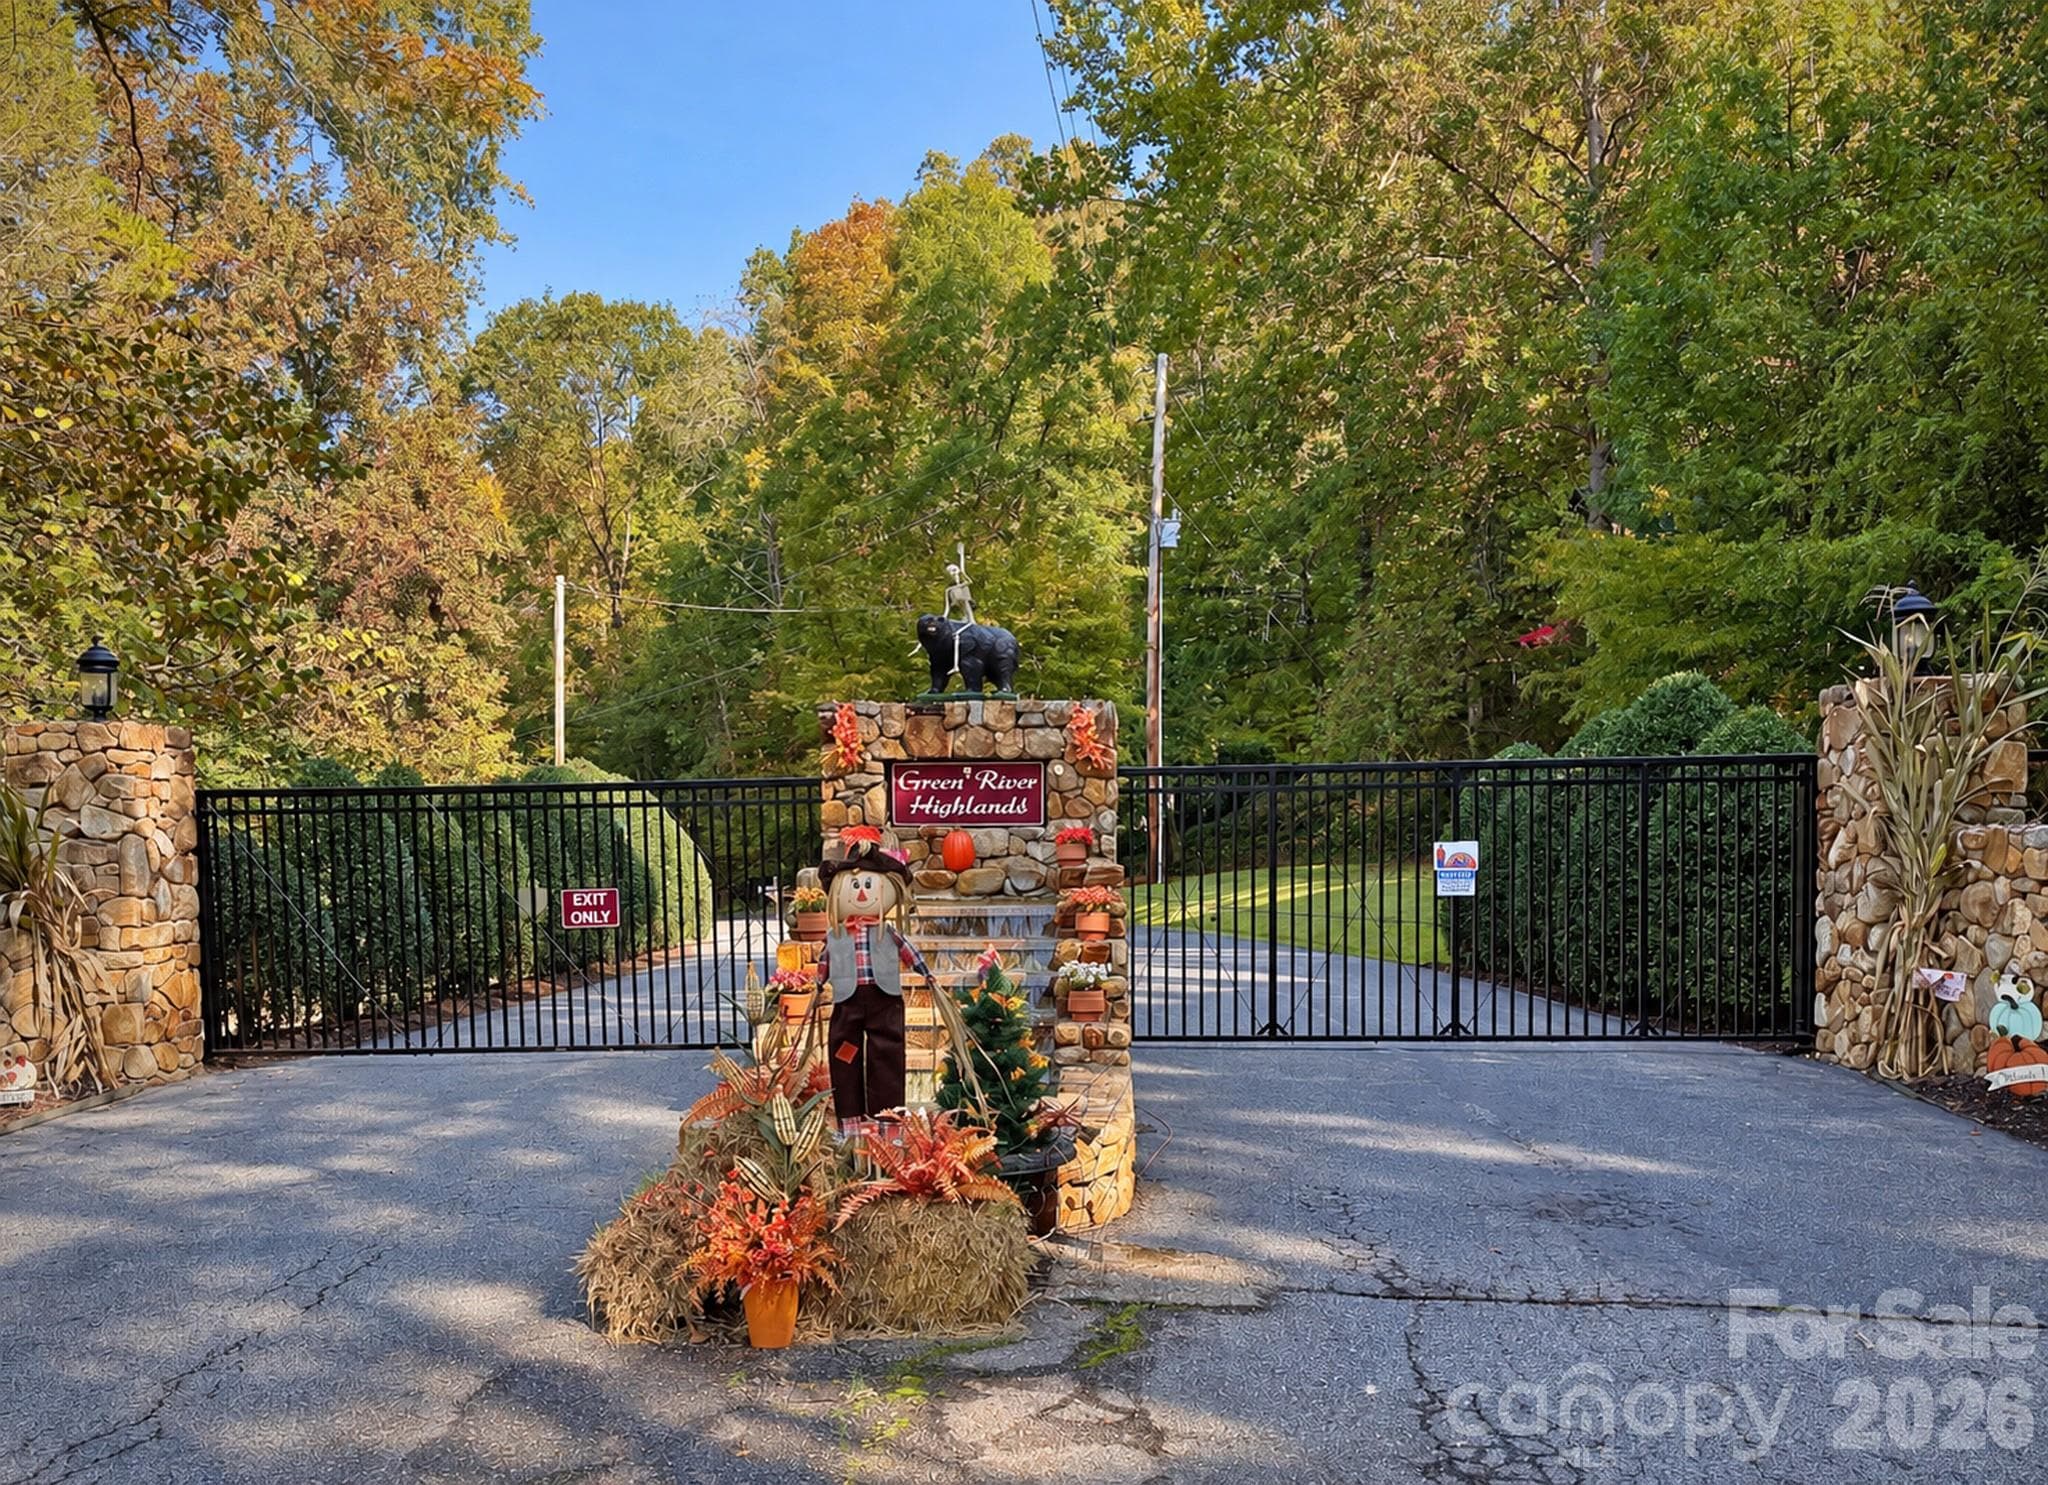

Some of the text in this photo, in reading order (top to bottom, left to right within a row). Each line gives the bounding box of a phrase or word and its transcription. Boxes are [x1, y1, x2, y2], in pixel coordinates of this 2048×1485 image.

[899, 769, 1038, 791] Green River
[910, 795, 1028, 819] Highlands
[573, 892, 608, 906] EXIT
[570, 910, 611, 924] ONLY
